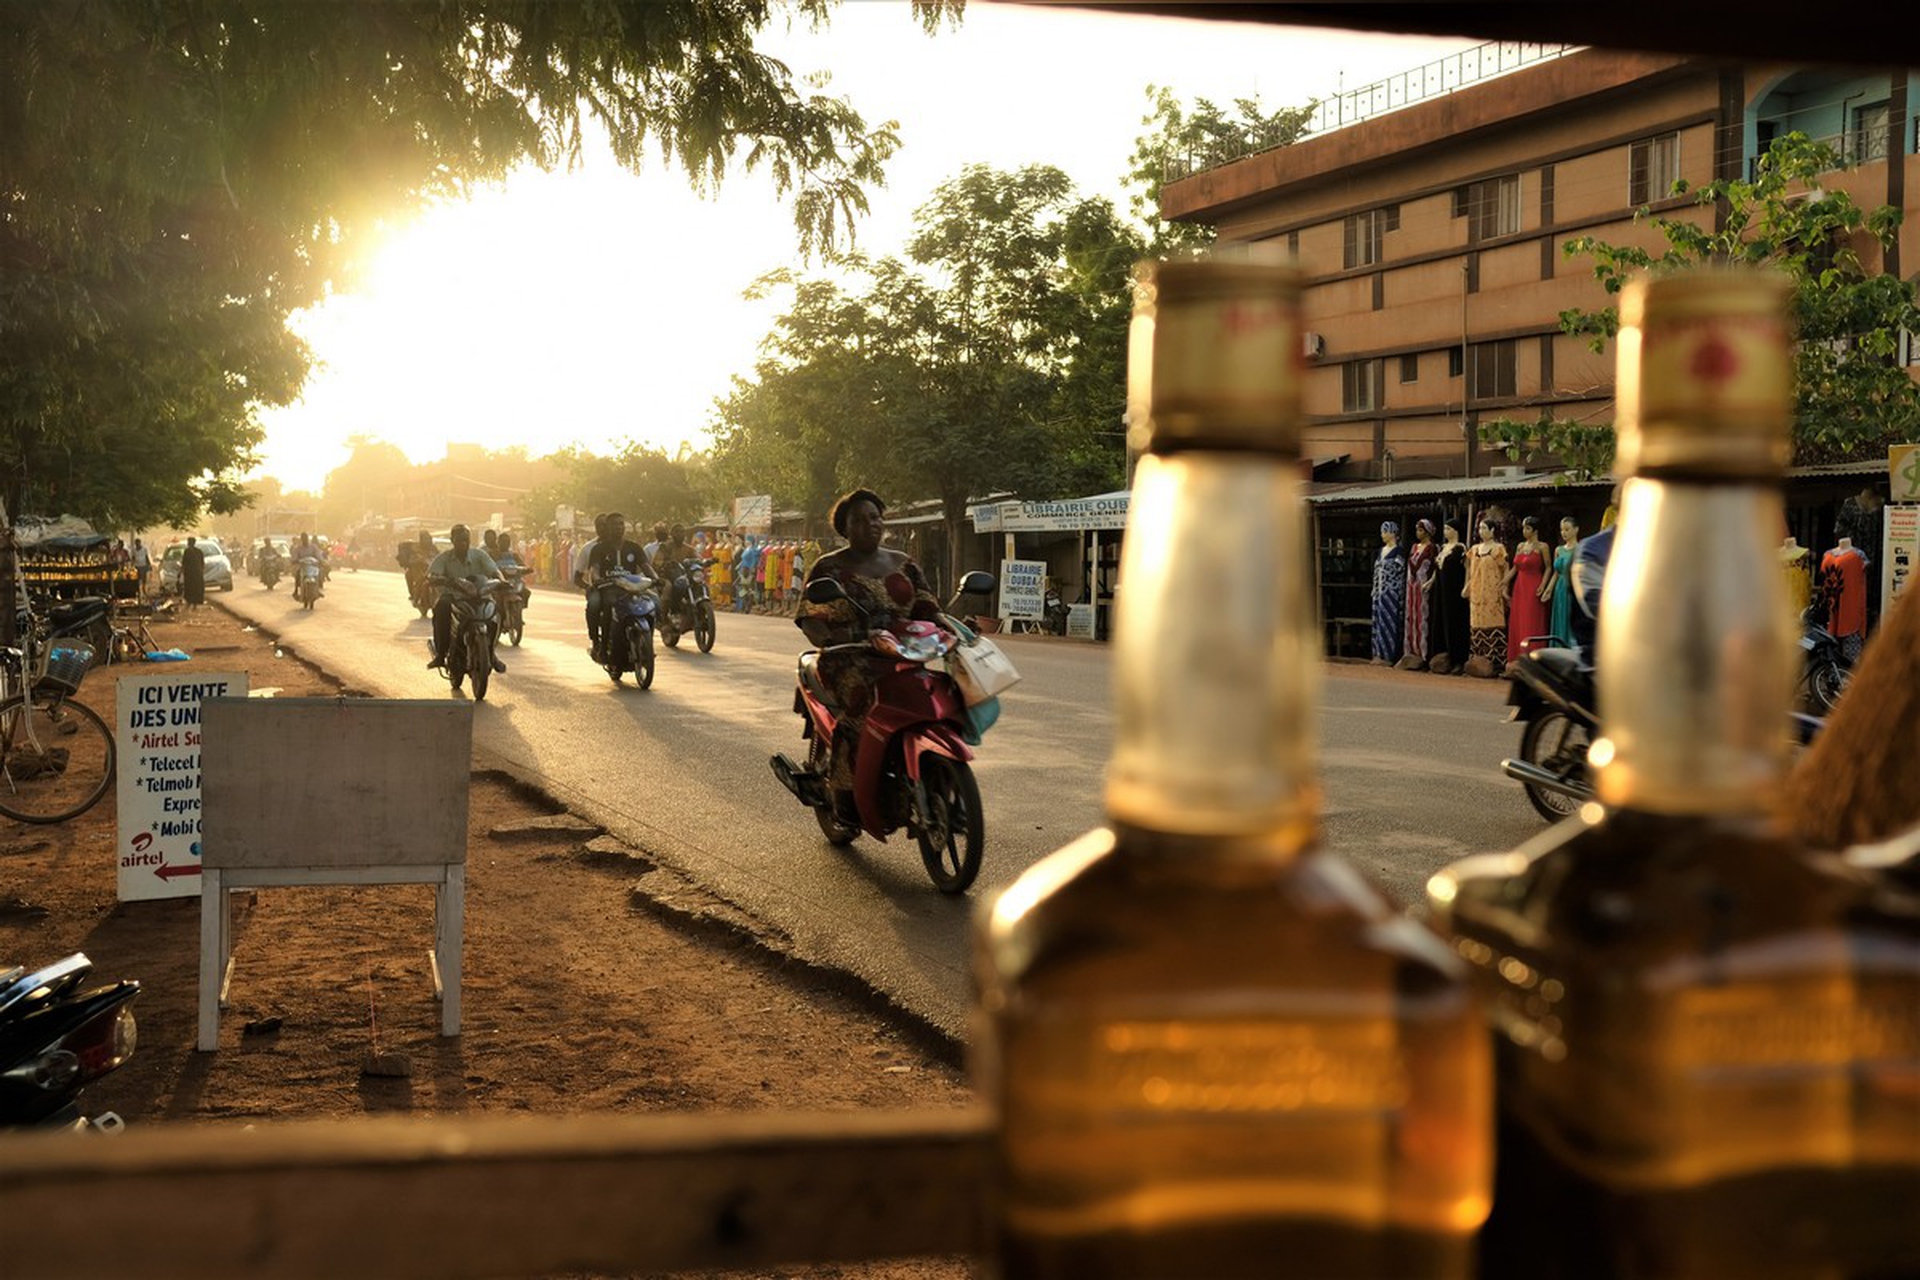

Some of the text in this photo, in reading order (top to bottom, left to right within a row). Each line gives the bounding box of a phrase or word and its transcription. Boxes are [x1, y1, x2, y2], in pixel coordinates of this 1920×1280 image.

[1023, 499, 1128, 514] LIBRAIRIE OUB
[1027, 511, 1087, 519] COMMERCE
[1006, 564, 1042, 576] LIBRAIRIE
[1011, 575, 1036, 586] OUBDA
[138, 682, 228, 704] ICI VENTE
[130, 707, 201, 728] DES UNI
[141, 732, 179, 749] Airtel
[149, 755, 194, 772] Telecel
[145, 775, 193, 793] Telmob
[163, 796, 201, 814] Expre
[160, 819, 194, 837] Mobi
[121, 851, 163, 867] airtel
